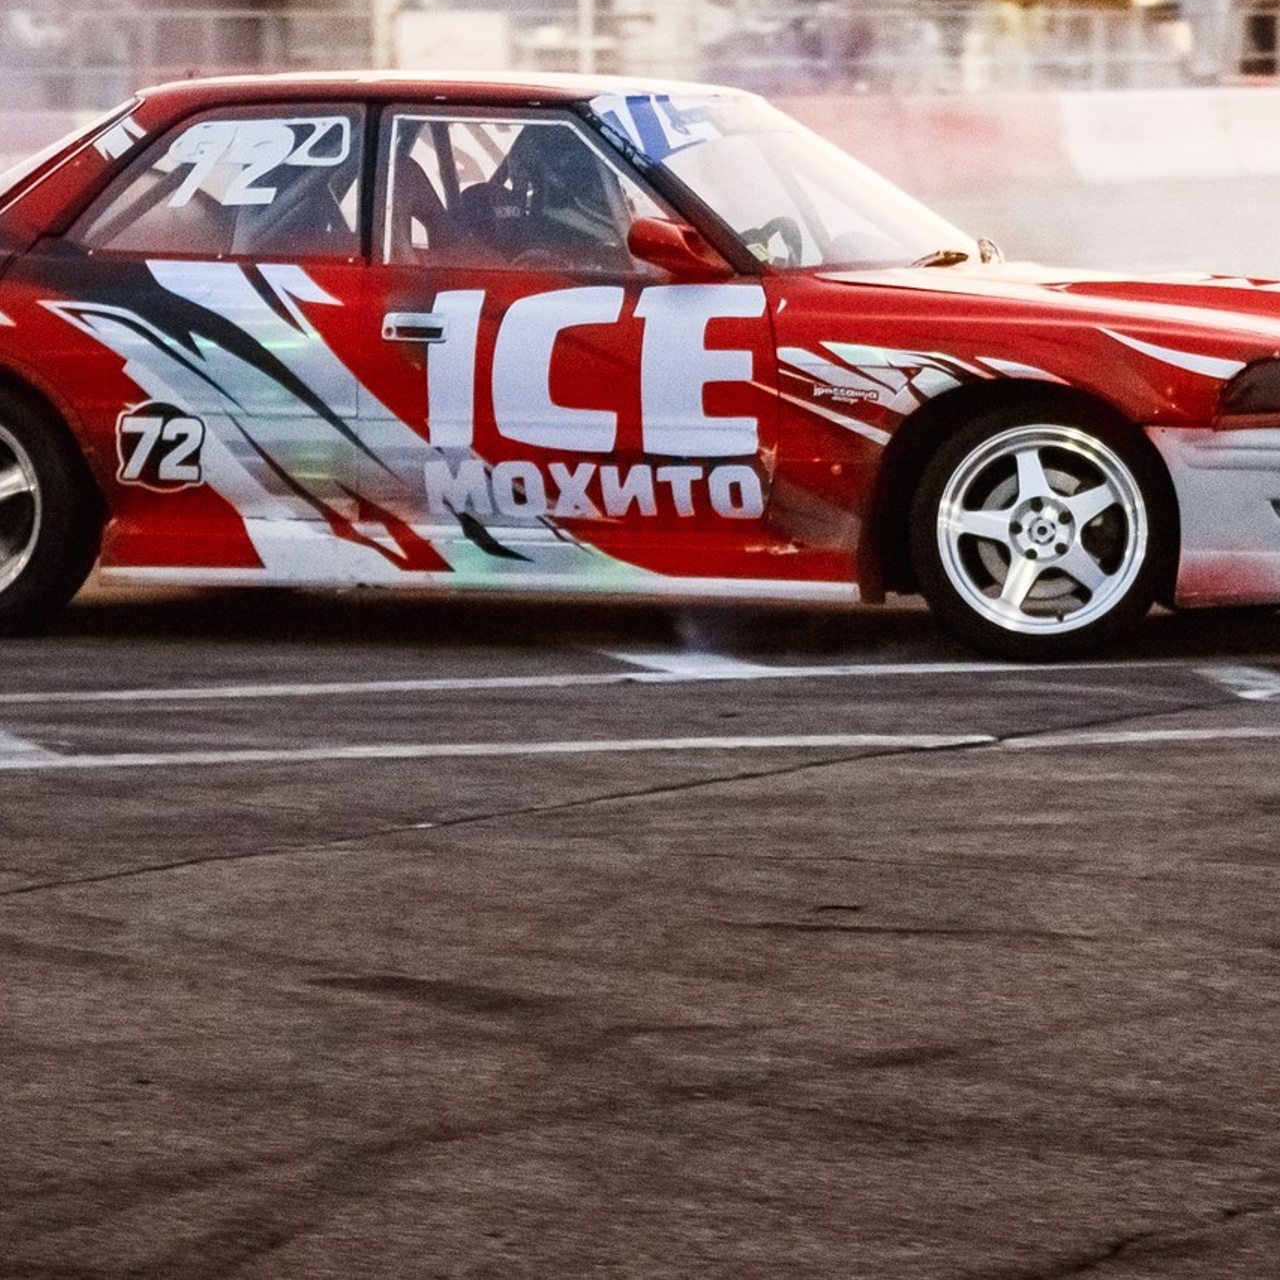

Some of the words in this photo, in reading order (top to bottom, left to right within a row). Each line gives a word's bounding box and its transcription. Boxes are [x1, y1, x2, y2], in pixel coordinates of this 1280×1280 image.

[167, 120, 295, 208] 72
[426, 283, 767, 457] ICE
[121, 416, 203, 480] 72
[424, 460, 764, 519] МОХИТО
